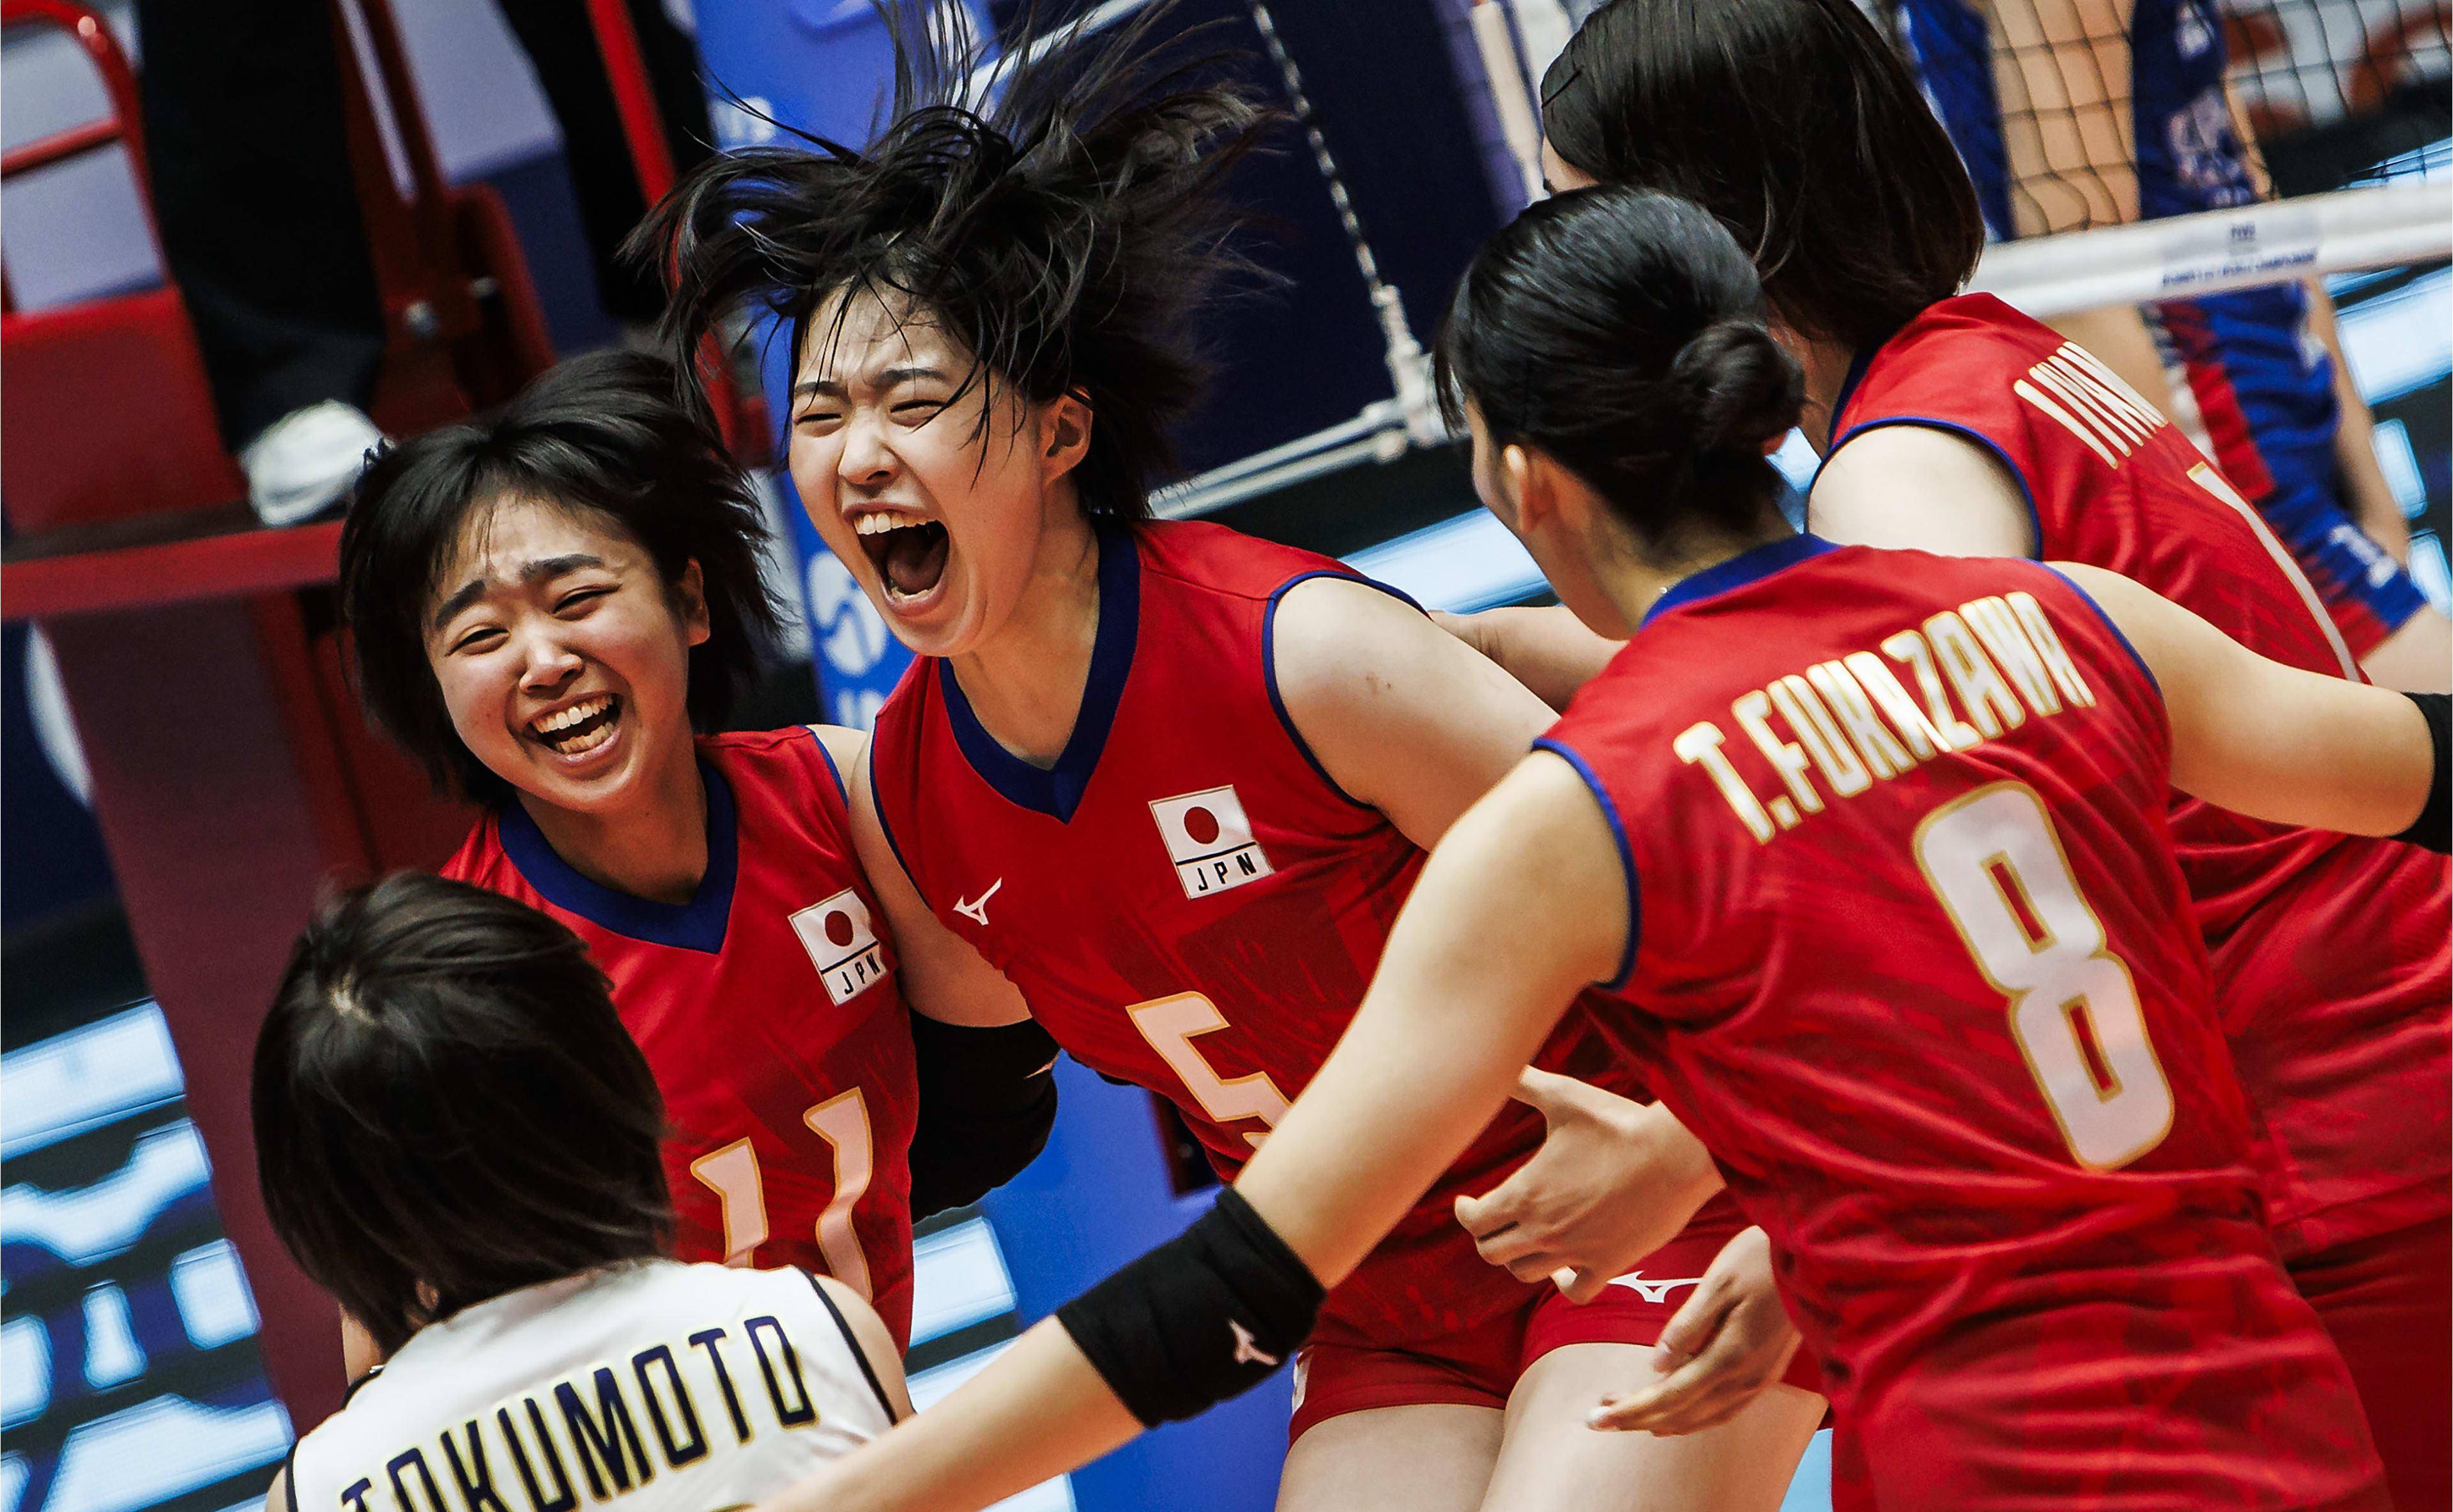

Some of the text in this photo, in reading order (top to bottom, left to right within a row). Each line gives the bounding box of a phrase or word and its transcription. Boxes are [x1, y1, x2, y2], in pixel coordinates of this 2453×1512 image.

[1673, 592, 2097, 845] T.FUKAZAWA
[1196, 851, 1257, 892] JPN
[841, 952, 881, 995] JPN
[1913, 781, 2174, 1173] 8
[1125, 991, 1294, 1151] 5
[690, 1085, 874, 1305] 11
